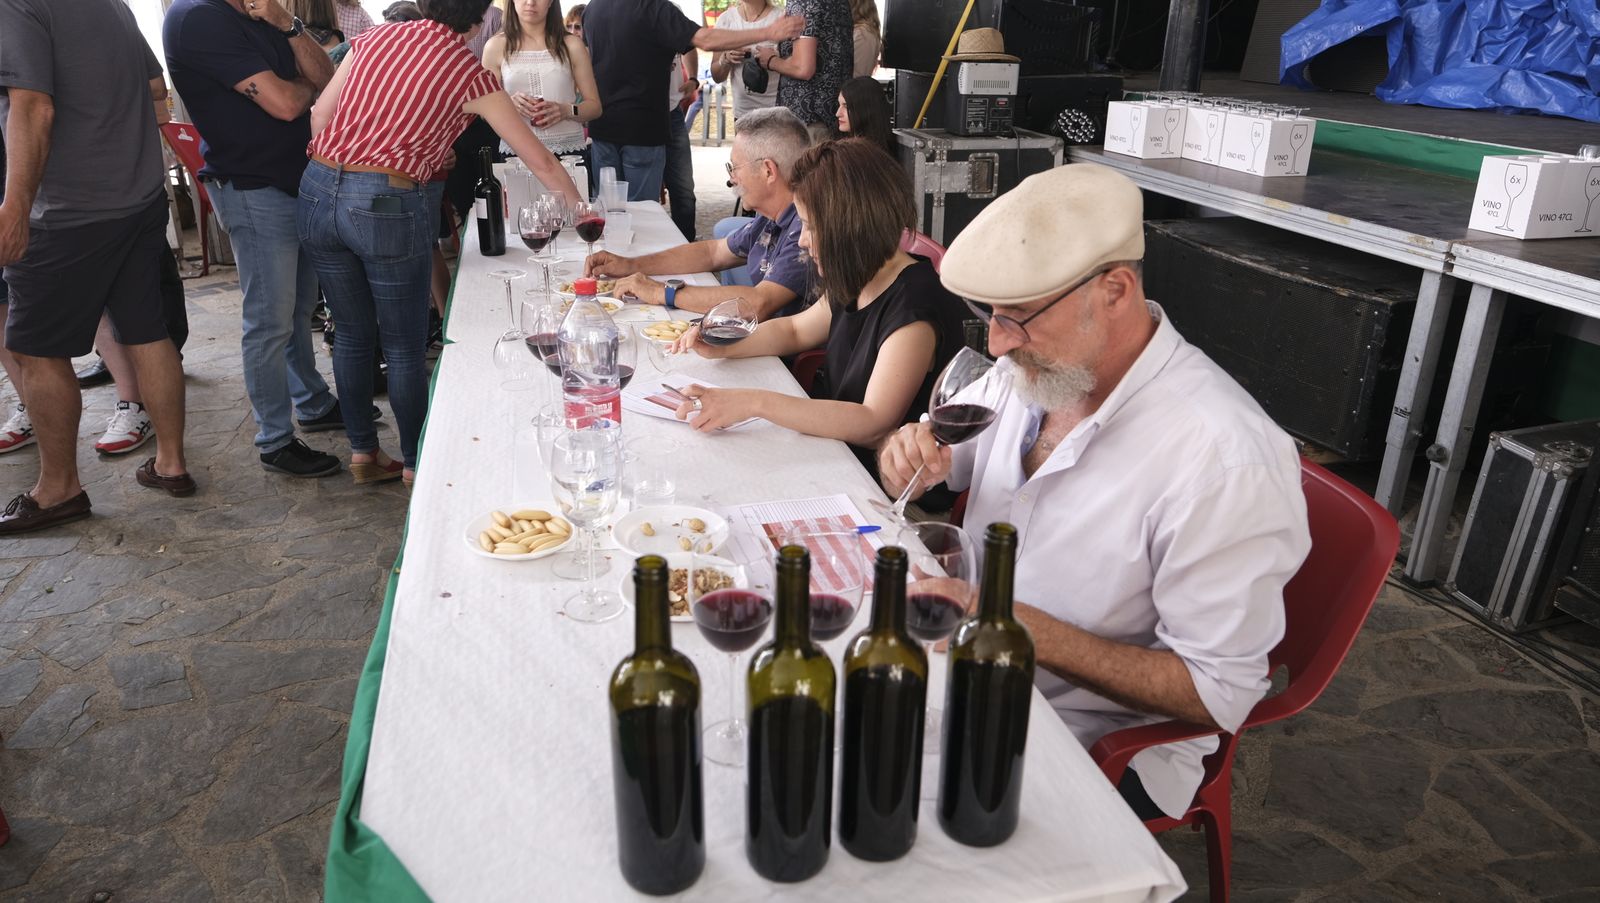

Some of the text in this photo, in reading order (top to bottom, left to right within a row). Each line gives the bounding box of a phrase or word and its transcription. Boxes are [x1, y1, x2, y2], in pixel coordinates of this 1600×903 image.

[1509, 175, 1521, 185] 6x
[1590, 177, 1600, 186] 6x
[1482, 199, 1502, 210] VINO
[1538, 213, 1573, 222] VINO 47CL
